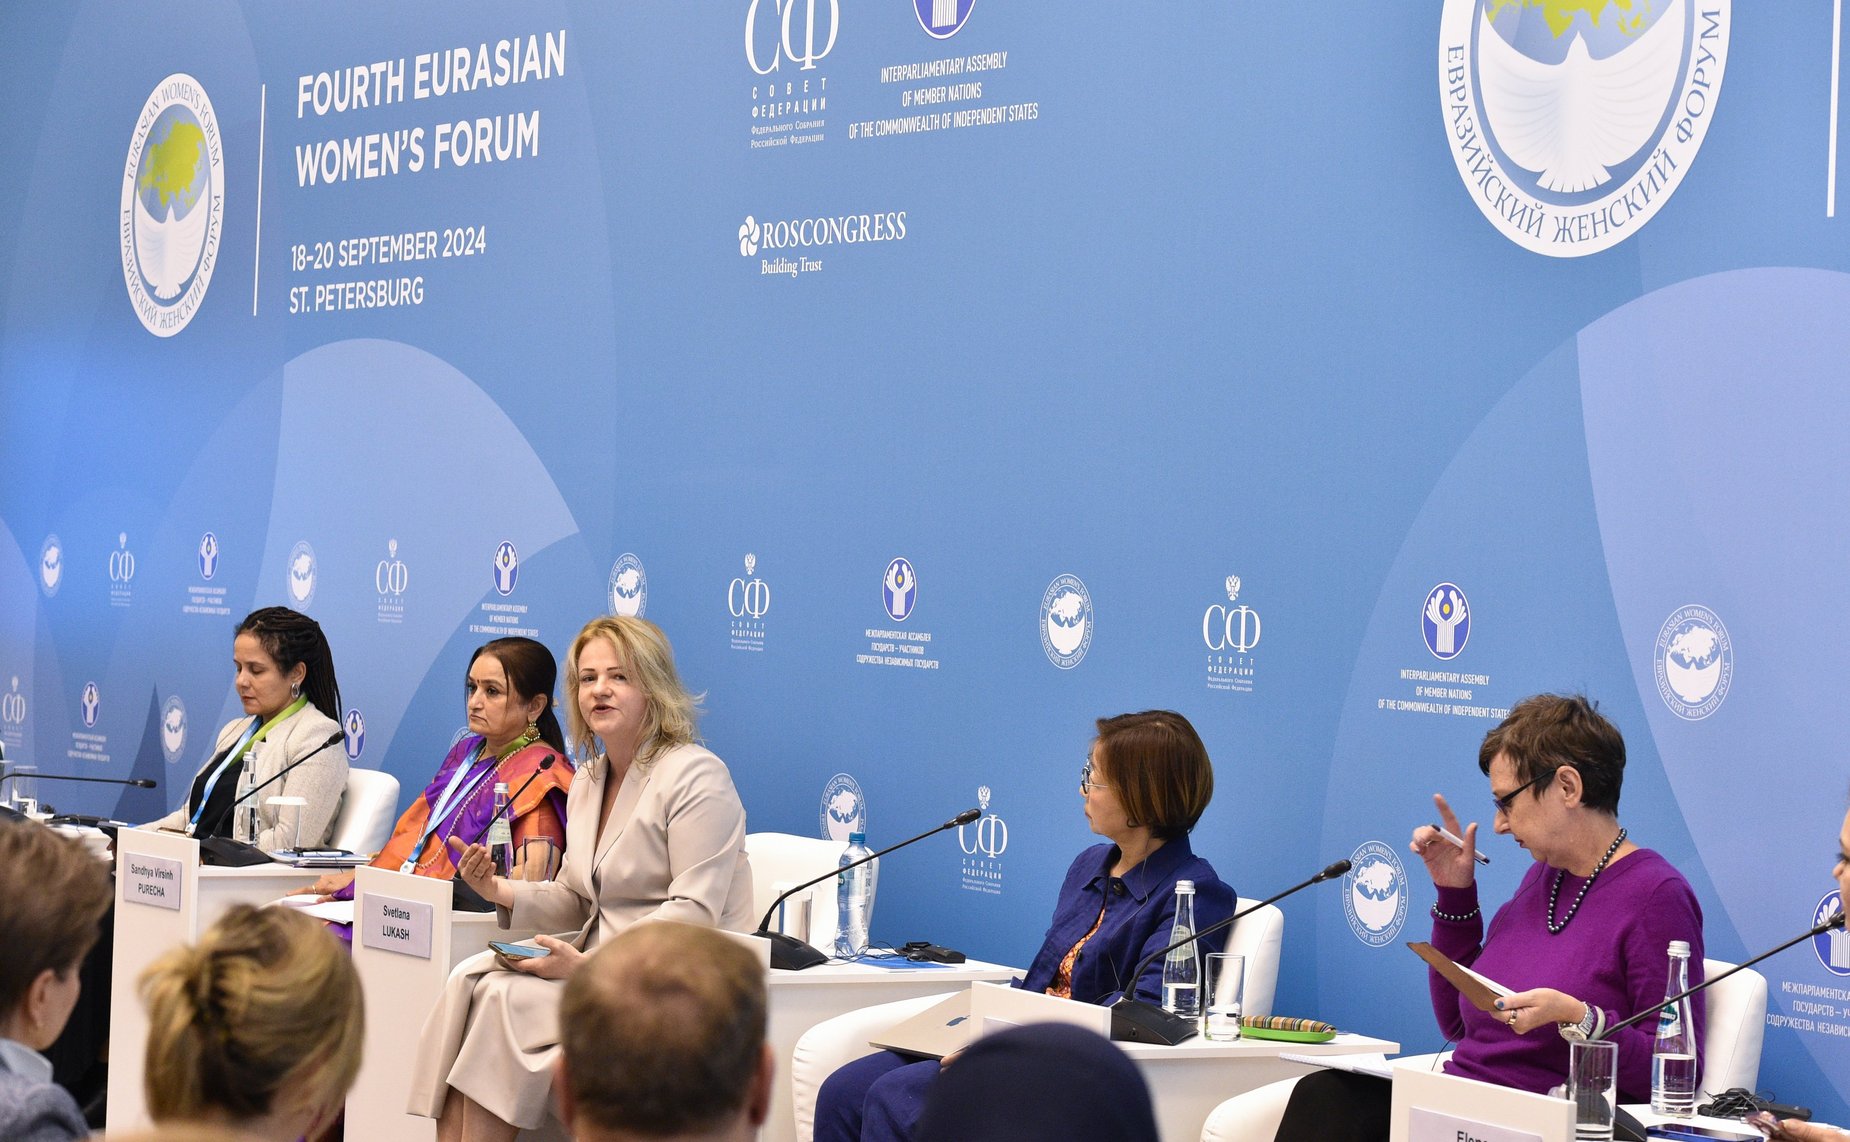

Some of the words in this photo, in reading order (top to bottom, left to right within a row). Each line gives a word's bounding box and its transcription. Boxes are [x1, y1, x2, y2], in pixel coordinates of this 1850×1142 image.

[297, 58, 405, 119] FOURTH
[414, 29, 566, 100] EURASIAN
[880, 57, 965, 84] INTERPARLIAMENTARY
[965, 51, 1008, 73] ASSEMBLY
[902, 91, 912, 107] OF
[913, 86, 946, 106] MEMBER
[948, 81, 982, 102] NATIONS
[127, 96, 160, 180] EURASIAN
[161, 82, 200, 110] WOMEN'S
[199, 106, 219, 168] FORUM
[848, 123, 859, 140] OF
[860, 120, 874, 138] THE
[875, 114, 940, 137] COMMONWEALTH
[941, 112, 952, 129] OF
[953, 106, 1008, 128] INDEPENDENT
[1008, 102, 1039, 122] STATES
[1447, 44, 1546, 239] ЕВРАЗИЙСКИЙ
[1552, 148, 1678, 243] ЖЕНСКИЙ
[1675, 9, 1721, 144] ФОРУМ
[295, 127, 425, 187] WOMEN'S
[434, 110, 540, 169] FORUM
[762, 211, 907, 249] ROSCONGRESS
[123, 209, 157, 326] ЕВРАЗИЙСКИЙ
[159, 275, 205, 329] ЖЕНСКИЙ
[203, 195, 221, 273] ФОРУМ
[291, 241, 334, 272] 18-20
[338, 230, 438, 267] SEPTEMBER
[442, 225, 486, 258] 2024
[761, 257, 798, 278] Building
[799, 256, 823, 272] Trust
[289, 286, 310, 314] ST.
[315, 276, 424, 312] PETERSBURG
[376, 560, 408, 596] СФ
[727, 577, 770, 619] СФ
[1202, 604, 1261, 653] СФ
[1400, 669, 1460, 683] INTERPARLIAMENTARY
[1460, 673, 1490, 686] ASSEMBLY
[1415, 686, 1423, 696] OF
[1424, 687, 1448, 698] MEMBER
[1448, 688, 1473, 700] NATIONS
[1378, 699, 1386, 709] OF
[1386, 699, 1396, 710] THE
[1397, 700, 1442, 714] COMMONWEALTH
[1443, 704, 1451, 714] OF
[1452, 705, 1490, 718] INDEPENDENT
[131, 863, 153, 879] Sandhya
[138, 883, 165, 898] PURECHA
[383, 904, 410, 921] Svetlana
[382, 924, 410, 941] LUKASH
[1766, 1013, 1815, 1032] СОДРУЖЕСТВА
[1792, 1000, 1834, 1017] ГОСУДАРСТВ
